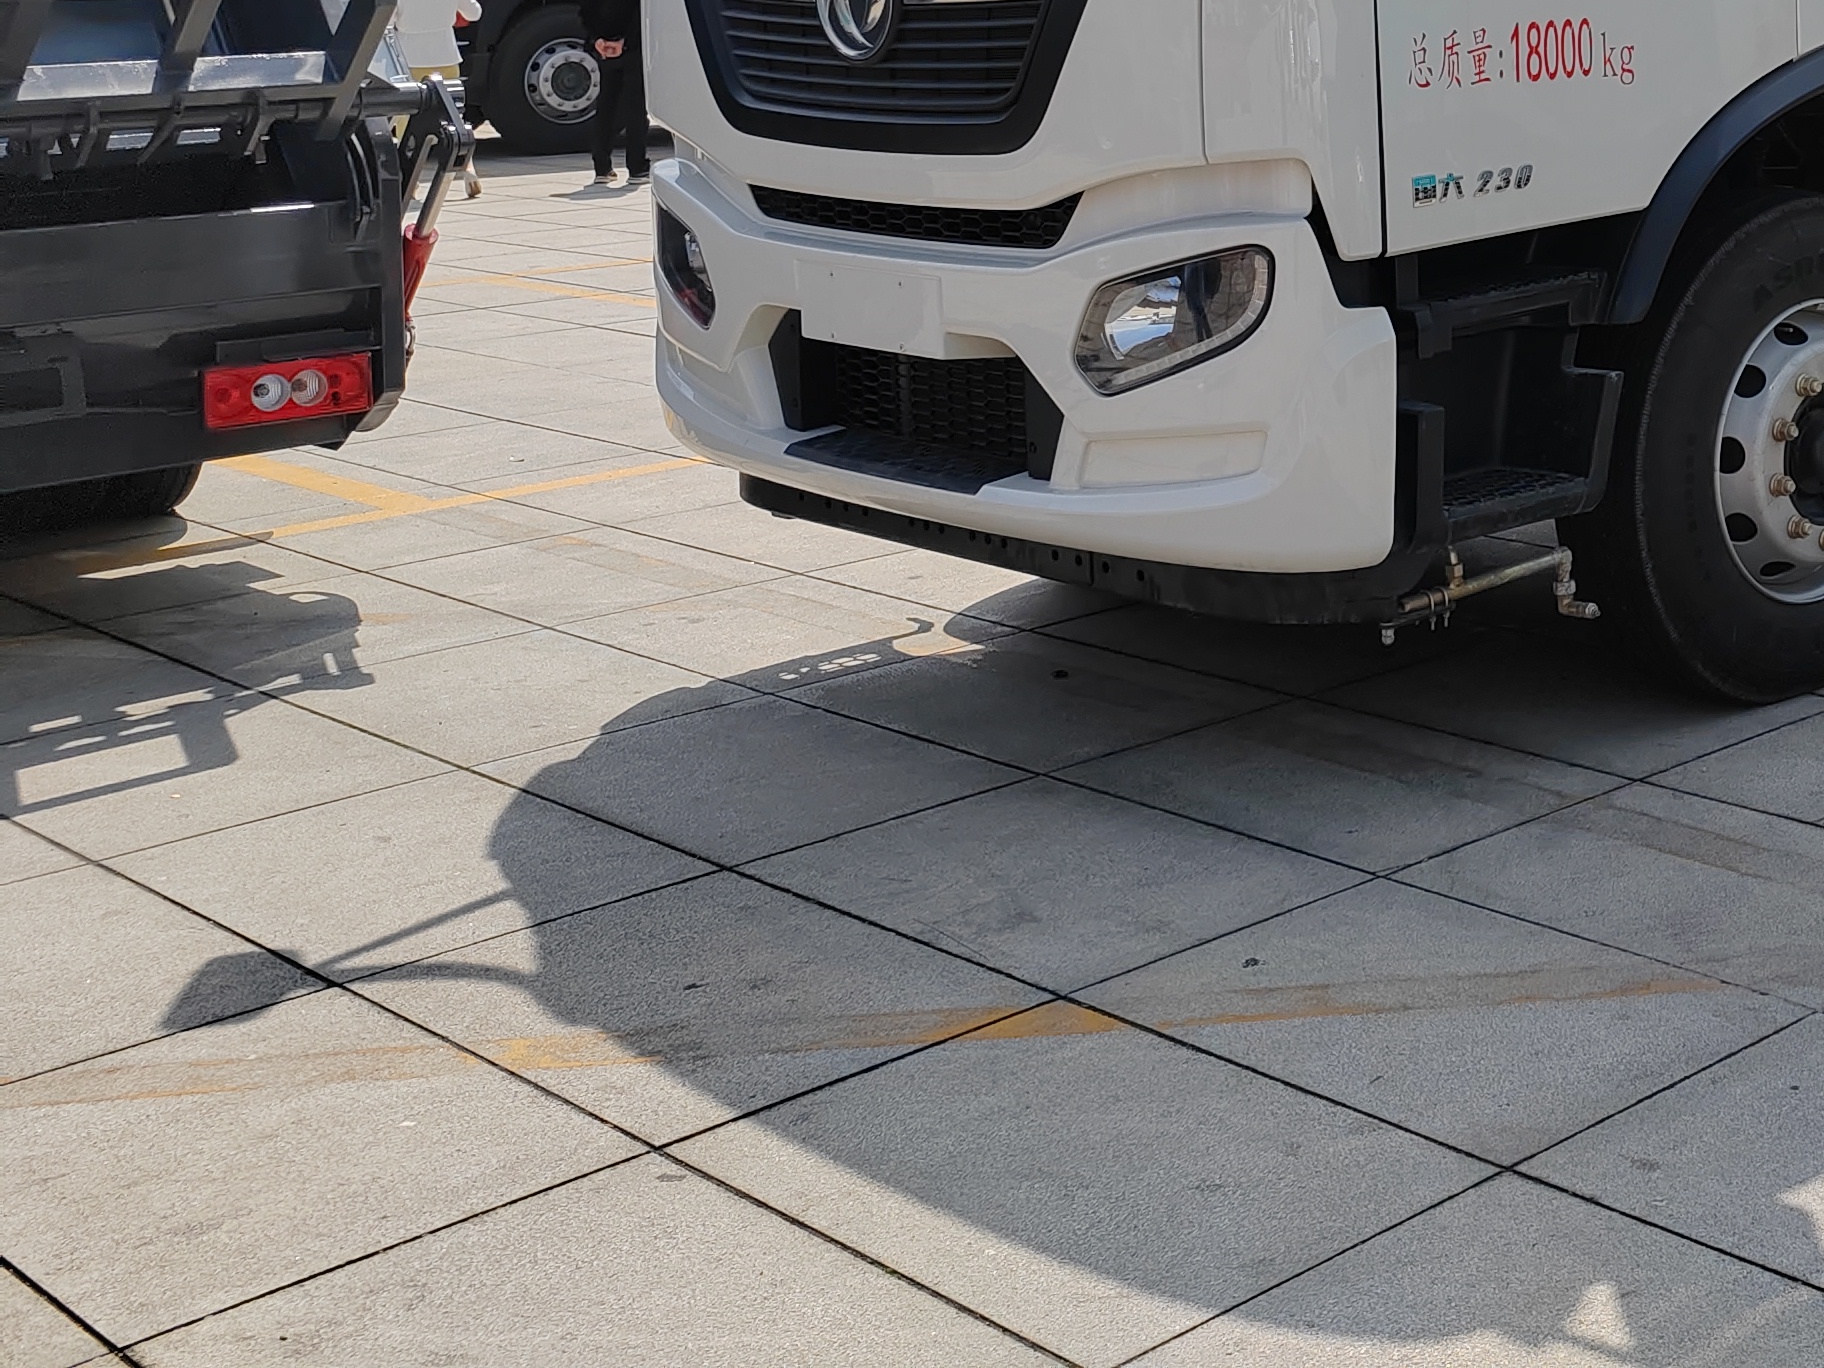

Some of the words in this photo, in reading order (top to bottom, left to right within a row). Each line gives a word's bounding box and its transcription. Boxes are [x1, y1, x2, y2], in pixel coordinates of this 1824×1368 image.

[1601, 31, 1635, 86] kg
[1411, 172, 1466, 209] 国六
[1472, 164, 1534, 198] 230
